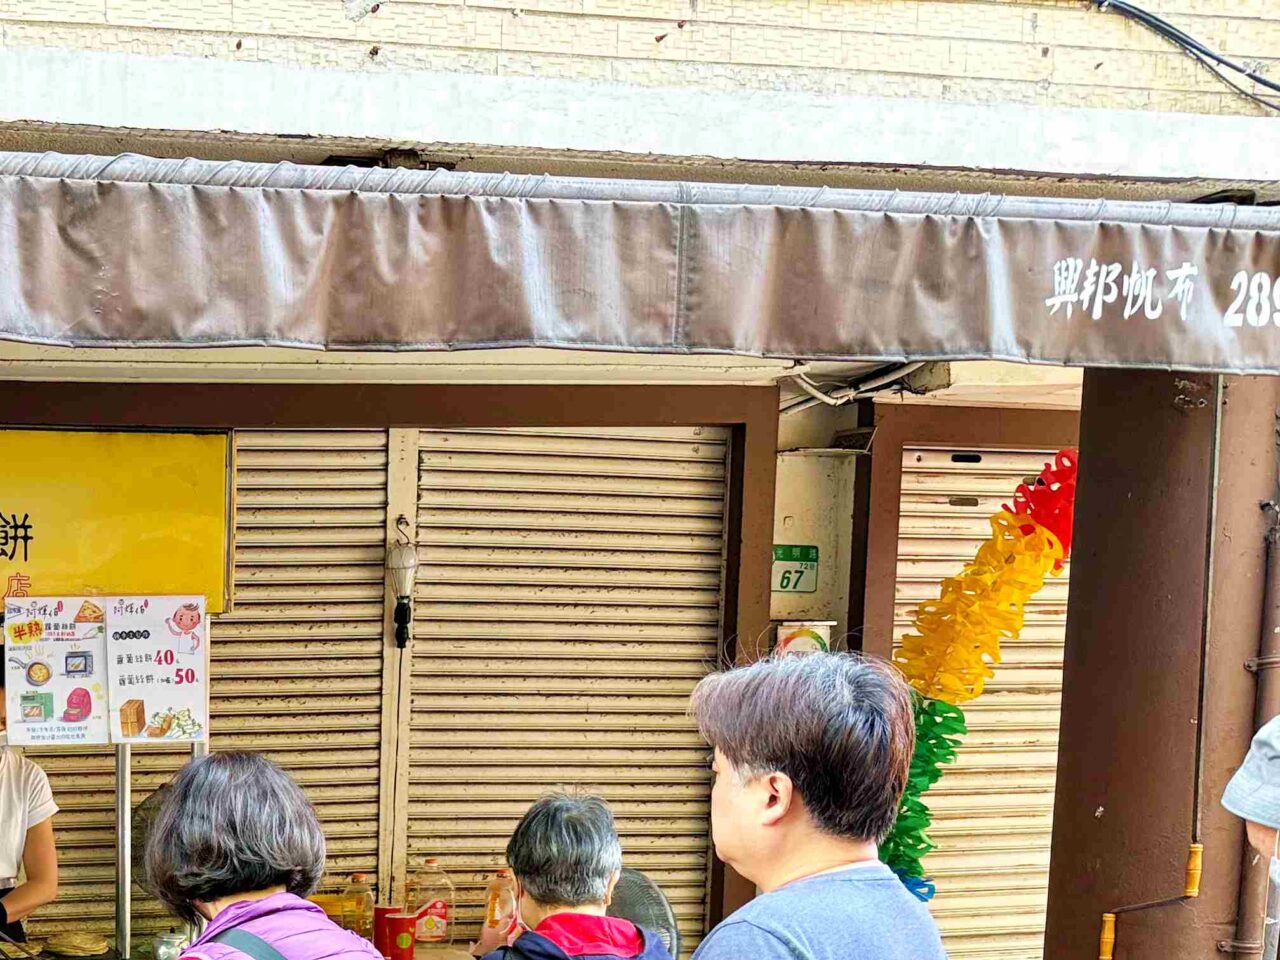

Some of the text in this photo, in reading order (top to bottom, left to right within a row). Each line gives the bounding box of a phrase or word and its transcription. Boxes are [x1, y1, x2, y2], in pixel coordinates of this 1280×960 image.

[780, 570, 805, 589] 67
[13, 621, 43, 640] 半熟
[154, 650, 174, 665] 40
[175, 668, 195, 685] 50
